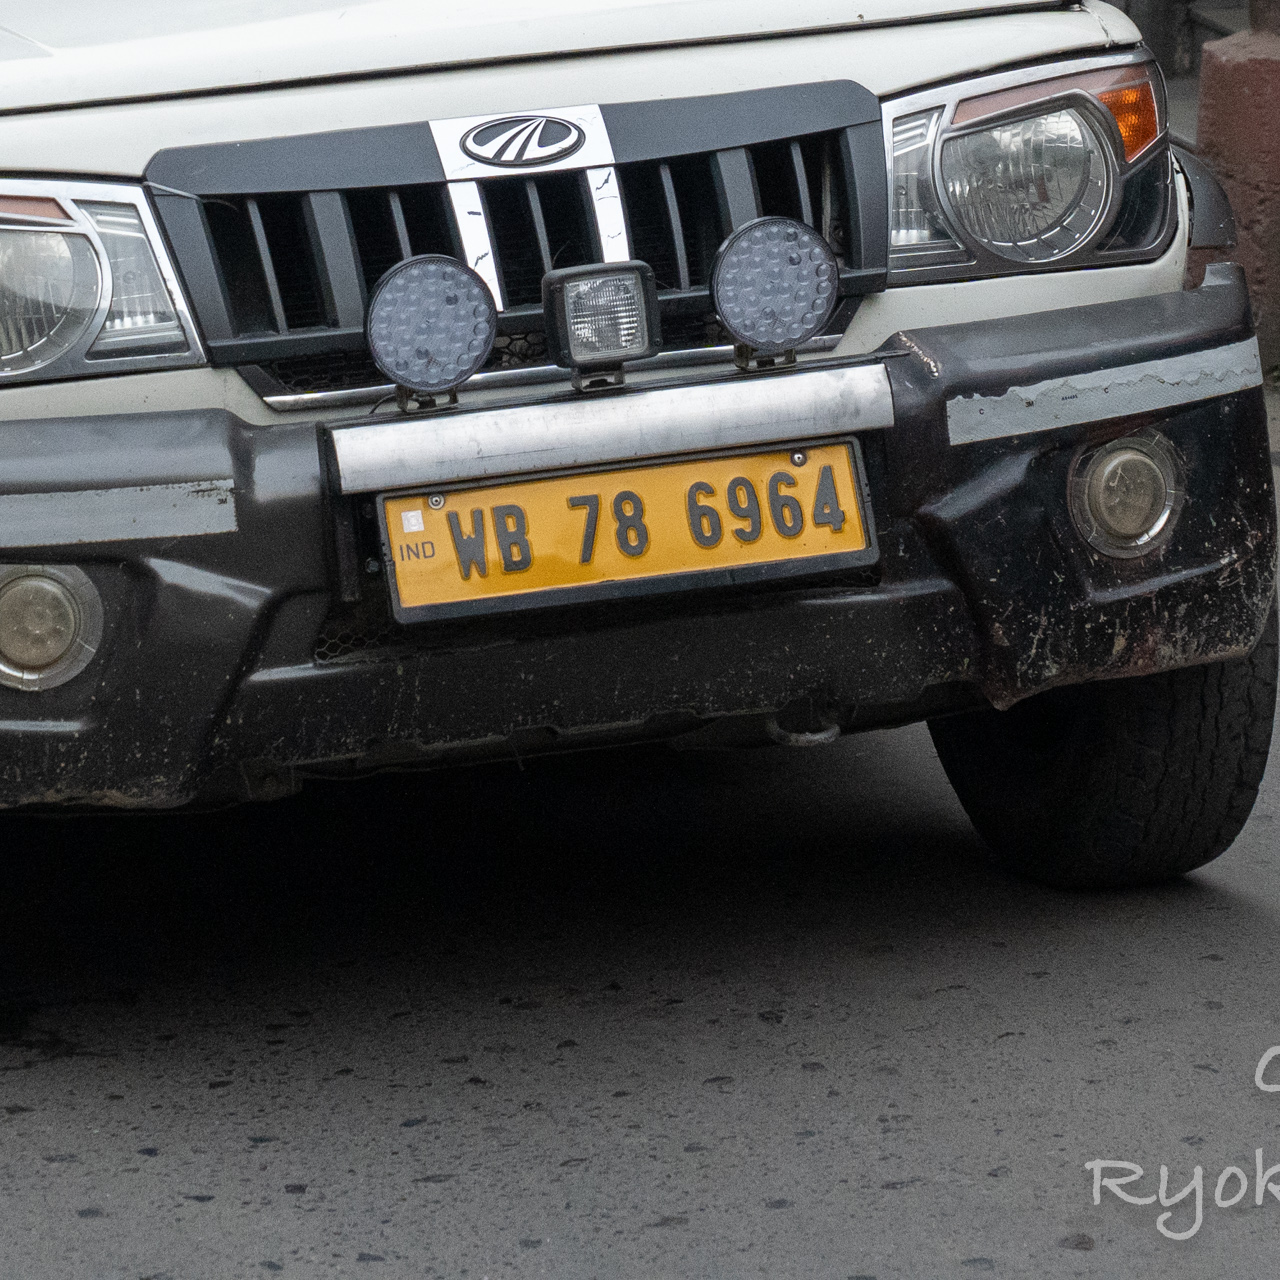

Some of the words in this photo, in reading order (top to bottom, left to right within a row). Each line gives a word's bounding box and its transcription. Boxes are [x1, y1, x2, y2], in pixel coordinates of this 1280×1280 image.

[399, 540, 435, 562] IND
[447, 504, 532, 580] WB
[568, 489, 650, 564] 78
[685, 465, 846, 548] 6964
